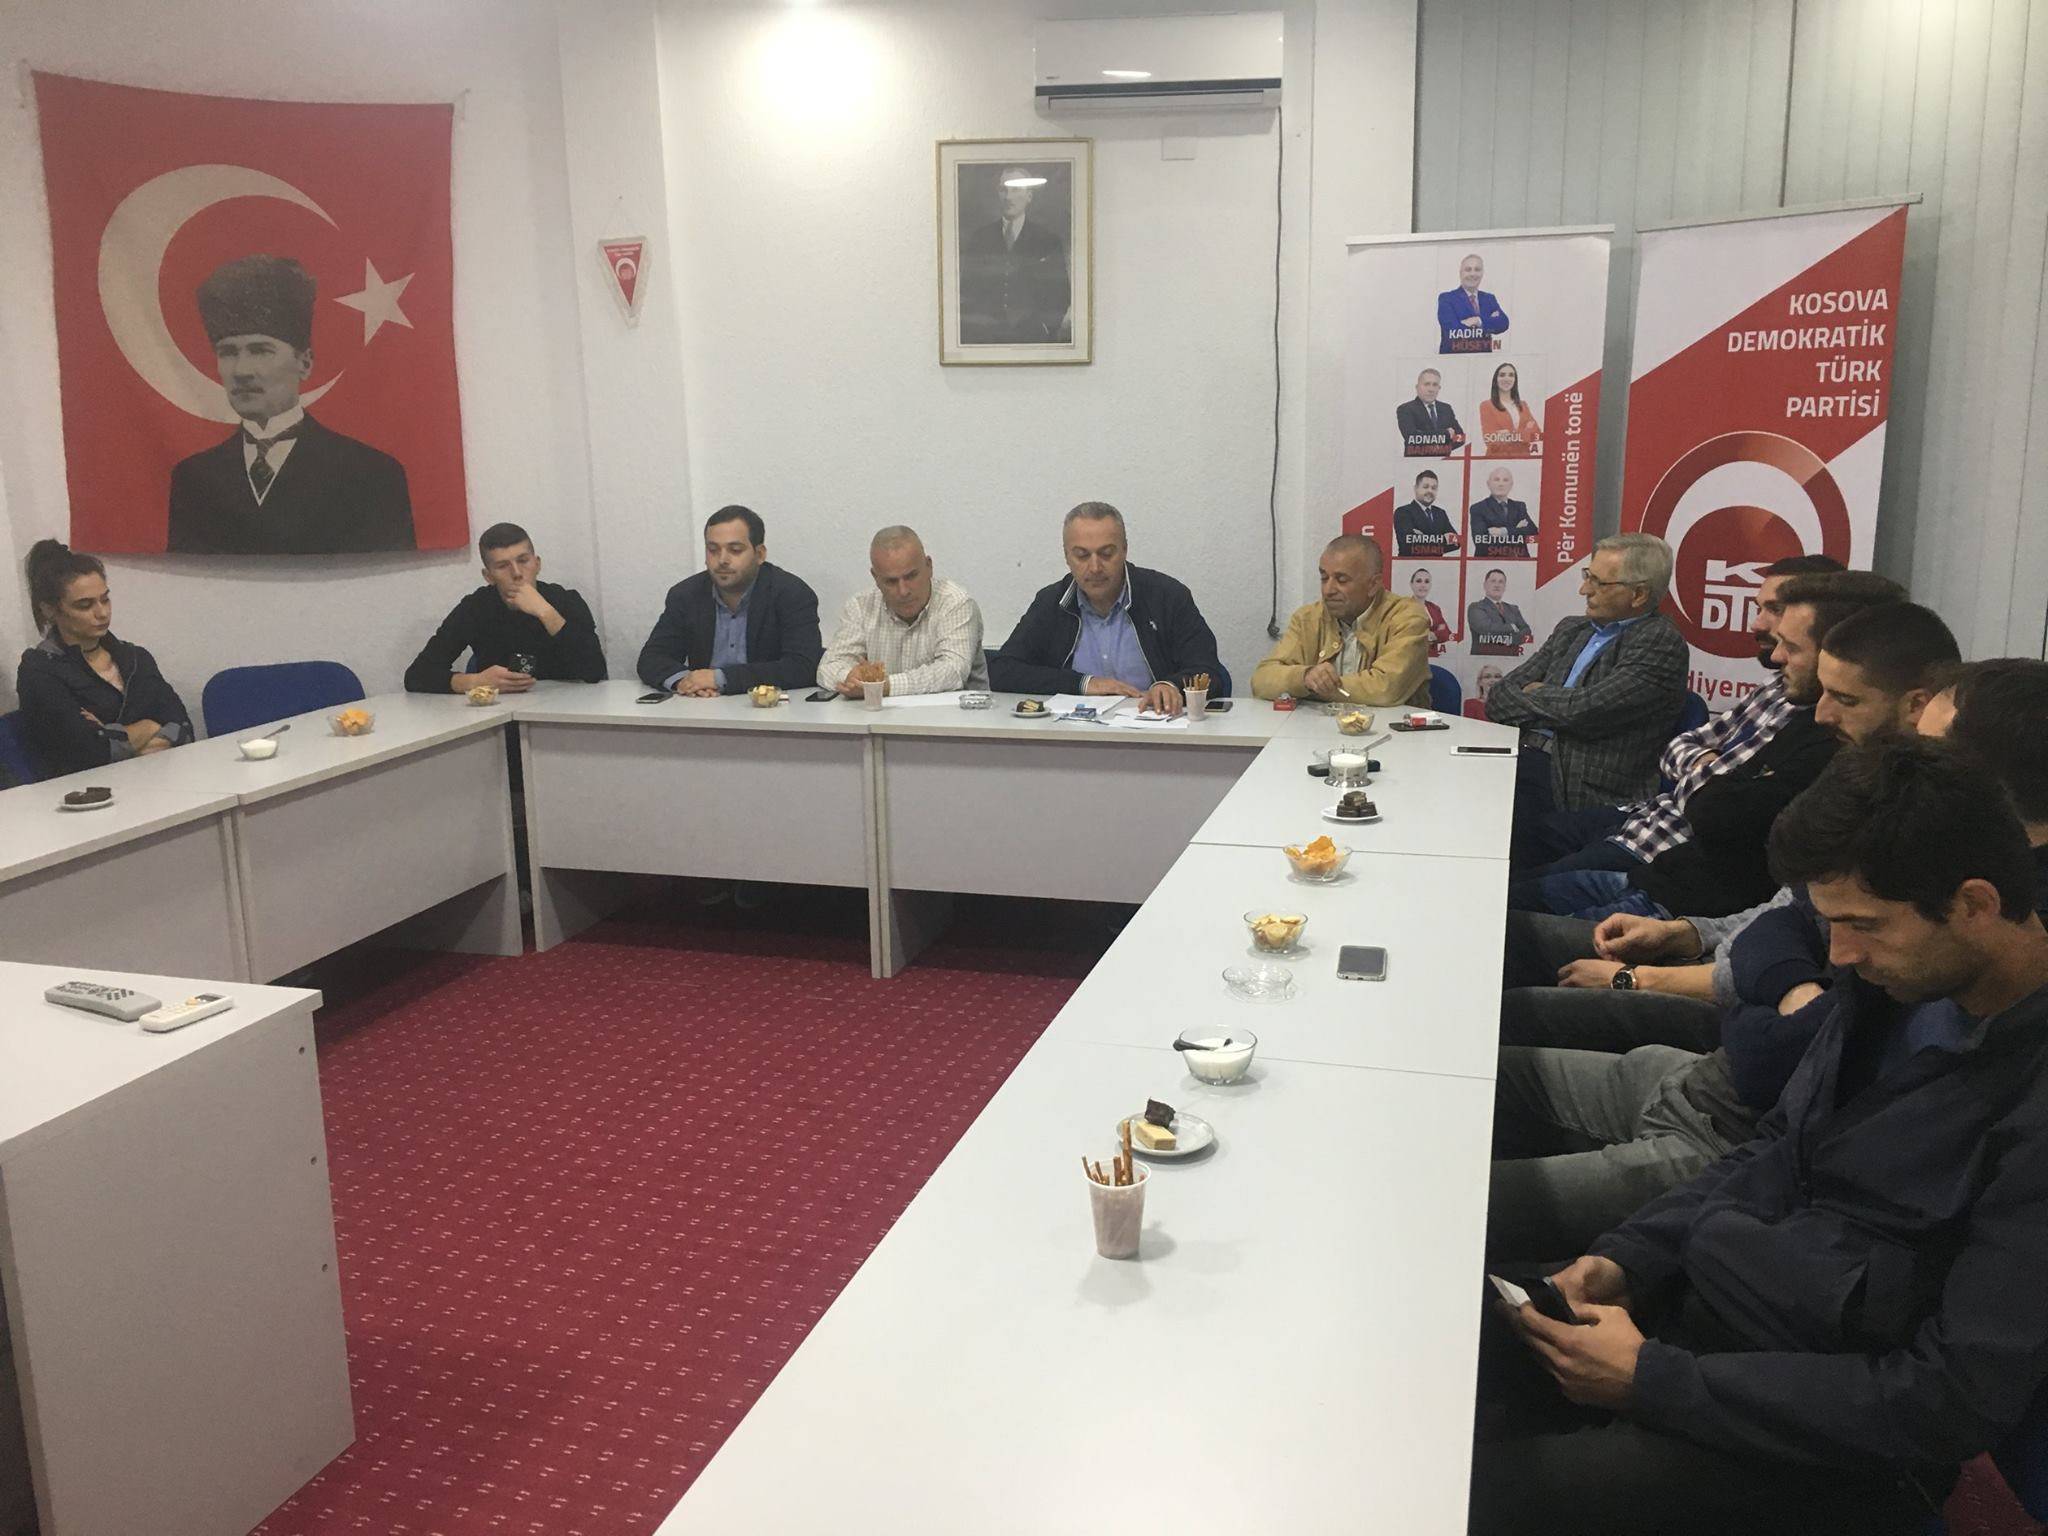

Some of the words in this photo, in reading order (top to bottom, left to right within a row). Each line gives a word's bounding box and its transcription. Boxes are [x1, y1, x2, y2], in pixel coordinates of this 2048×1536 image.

[1789, 288, 1888, 316] KOSOVA
[1449, 326, 1483, 339] KADİR
[1728, 318, 1887, 353] DEMOKRATİK
[1816, 355, 1883, 383] TÜRK
[1564, 392, 1583, 434] tonë
[1786, 389, 1881, 418] PARTİSİ
[1408, 434, 1446, 445] ADNAN
[1559, 440, 1580, 528] Komunën
[1405, 534, 1444, 544] EMRAH
[1557, 531, 1574, 564] Për
